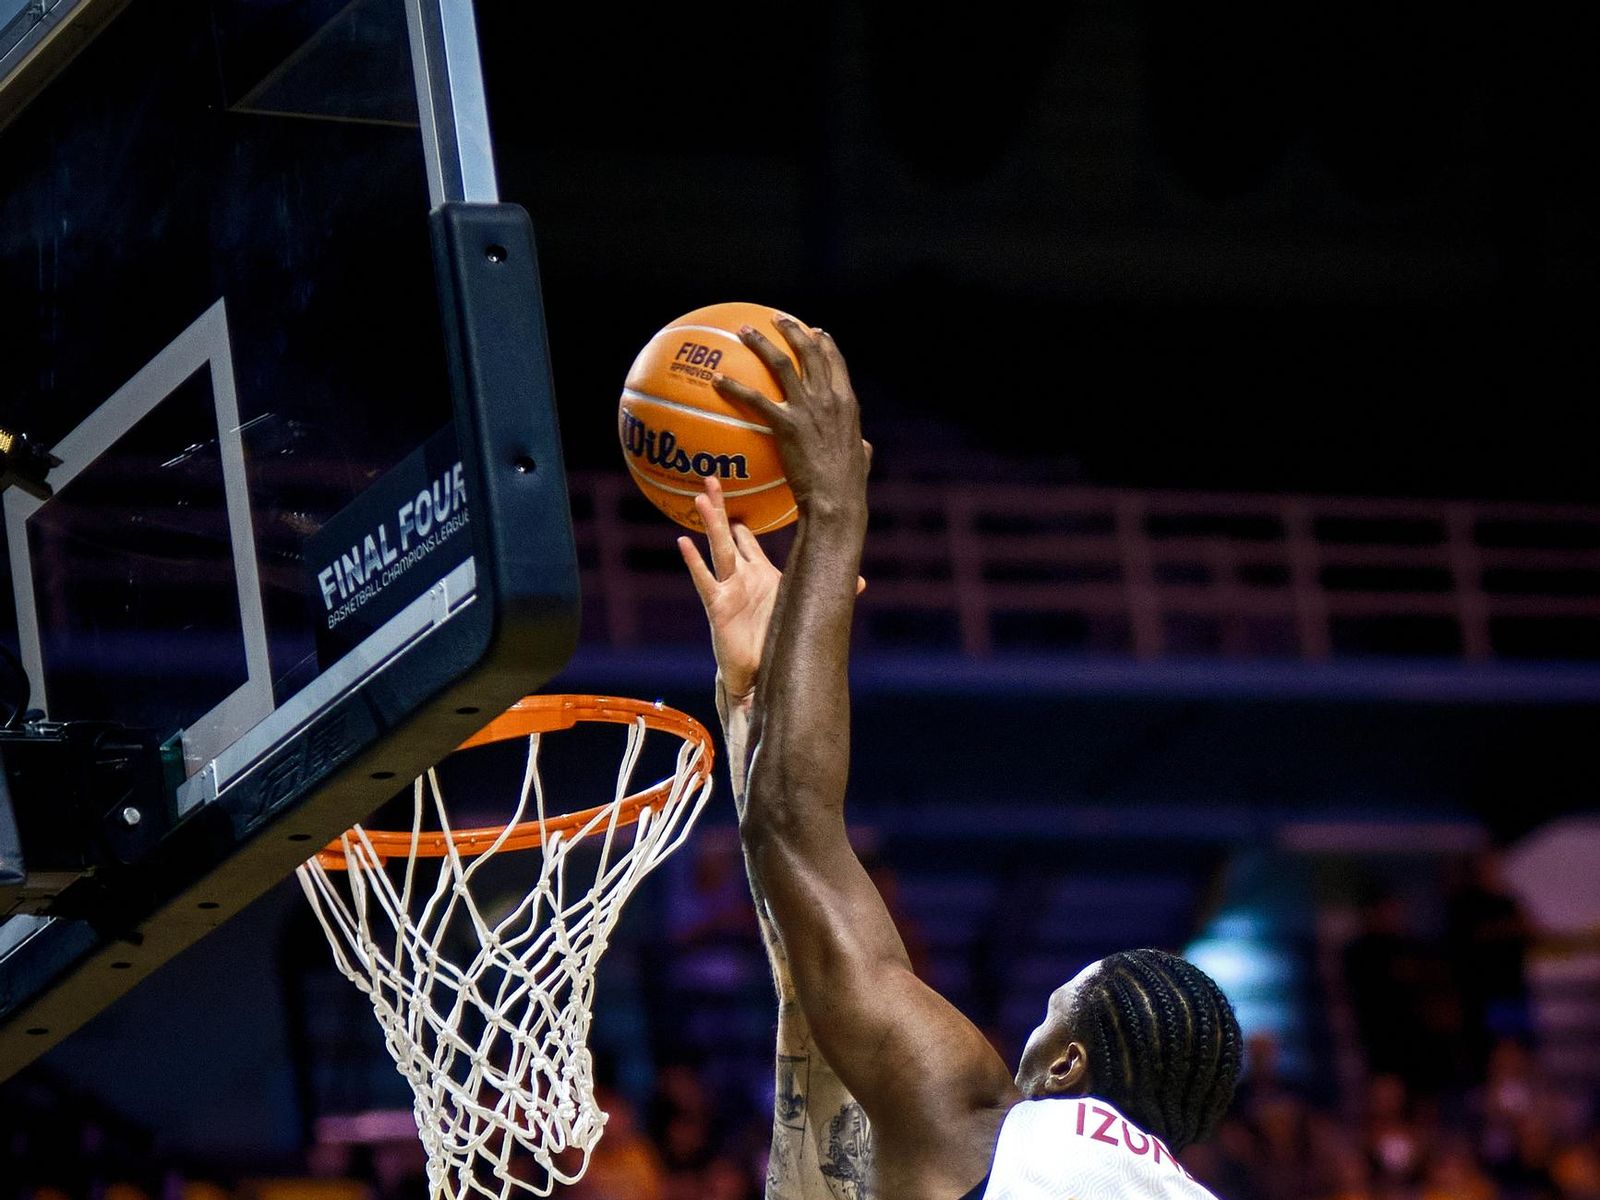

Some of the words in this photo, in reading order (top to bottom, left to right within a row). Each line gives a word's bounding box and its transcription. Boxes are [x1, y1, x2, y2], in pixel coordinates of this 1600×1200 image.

[675, 341, 723, 370] FIBA
[622, 407, 750, 480] Wilson
[317, 523, 397, 610] FINAL
[399, 461, 467, 551] FOUR
[328, 580, 383, 630] BASKETBALL
[382, 535, 435, 587] CHAMPIONS
[434, 508, 471, 545] LEAGUE
